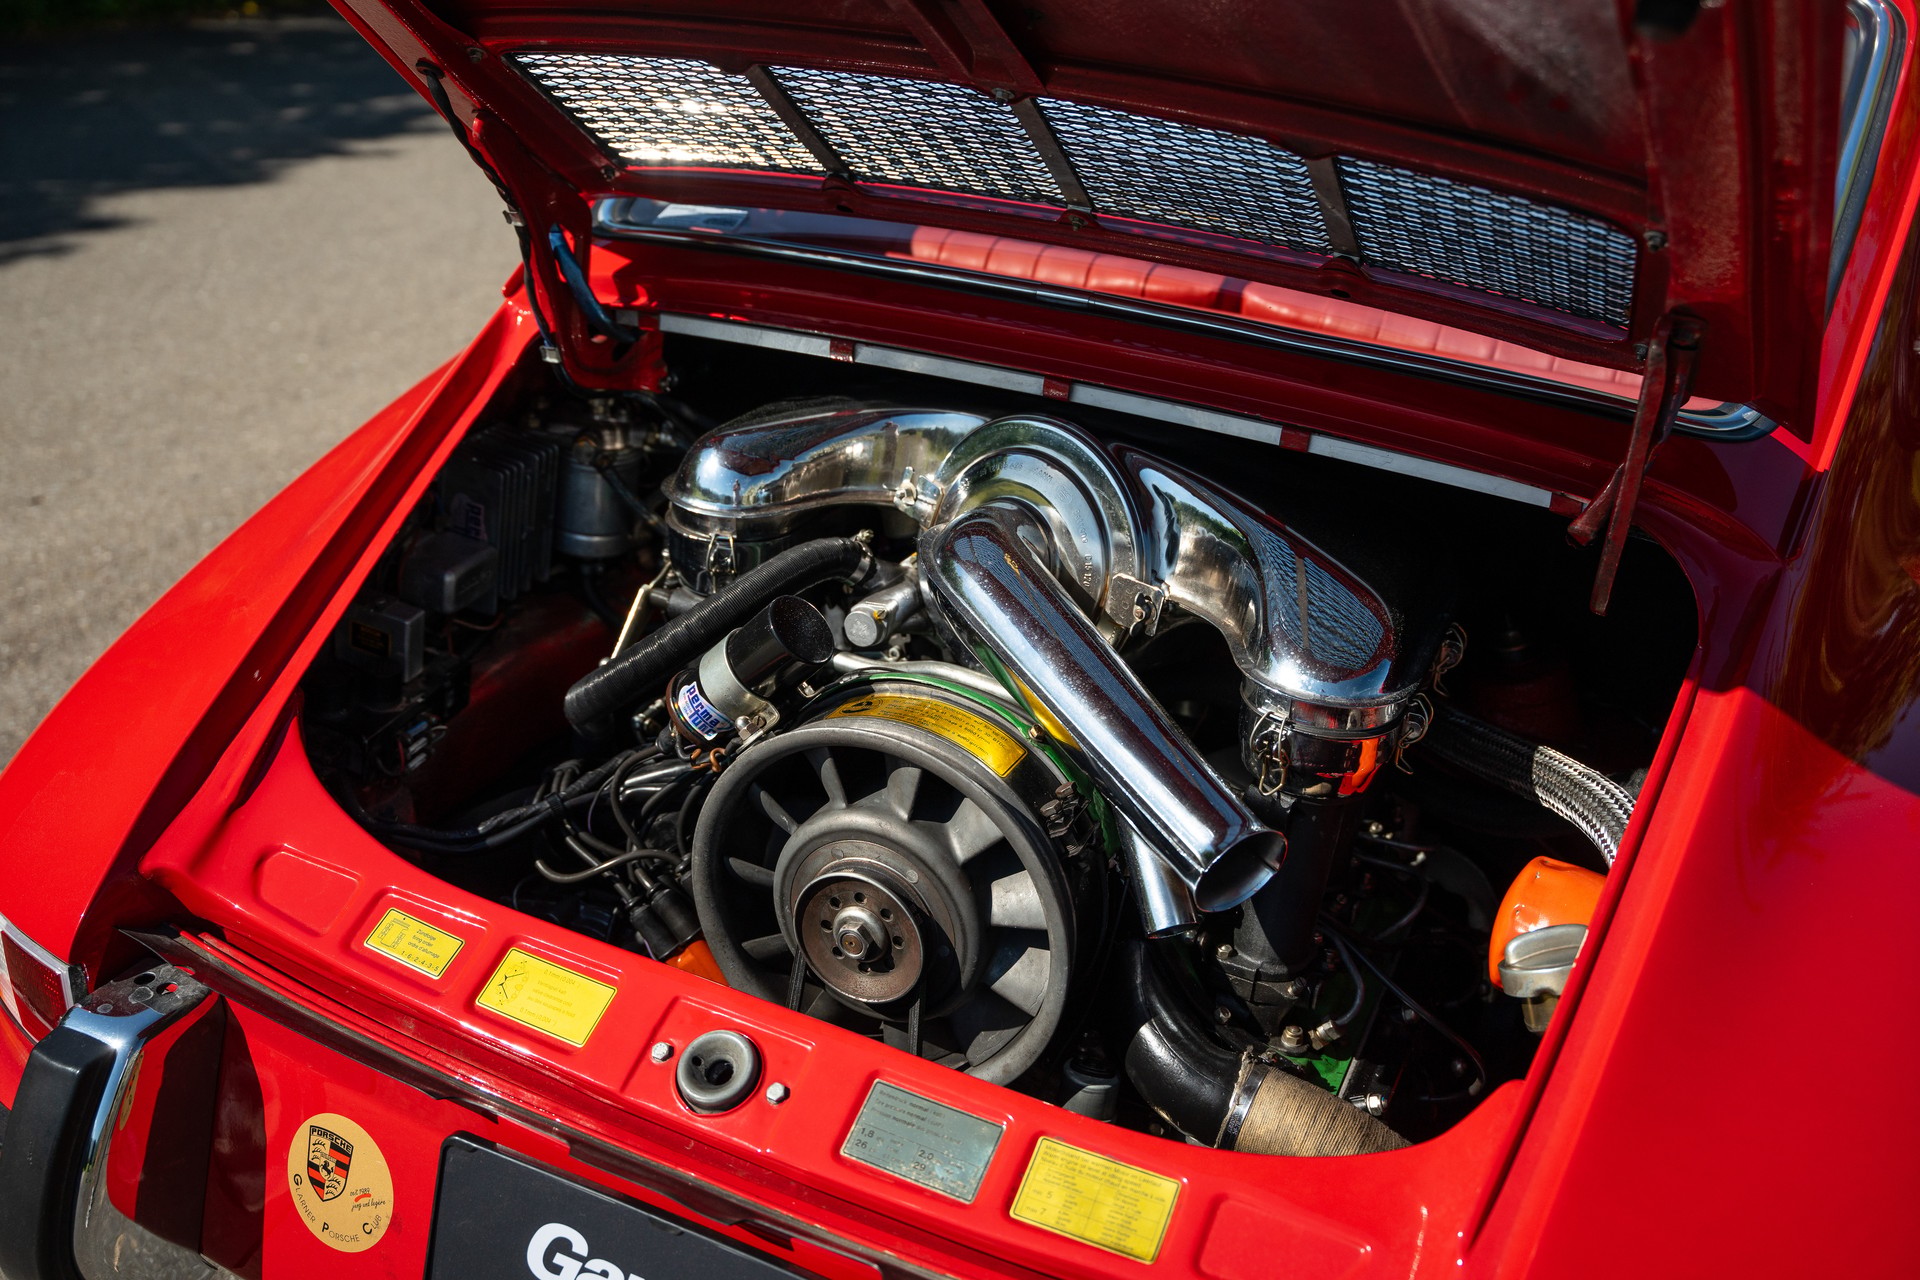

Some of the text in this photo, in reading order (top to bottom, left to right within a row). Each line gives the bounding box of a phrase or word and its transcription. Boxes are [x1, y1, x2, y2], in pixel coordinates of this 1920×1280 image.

[687, 684, 720, 728] perma
[909, 1102, 929, 1112] normal
[906, 1110, 927, 1121] normal
[312, 1127, 352, 1155] PORSCHE
[855, 1139, 868, 1149] 26
[913, 1162, 926, 1171] 29
[1046, 1191, 1053, 1199] 5
[293, 1174, 382, 1243] GLARNER PORSCHE CLUB
